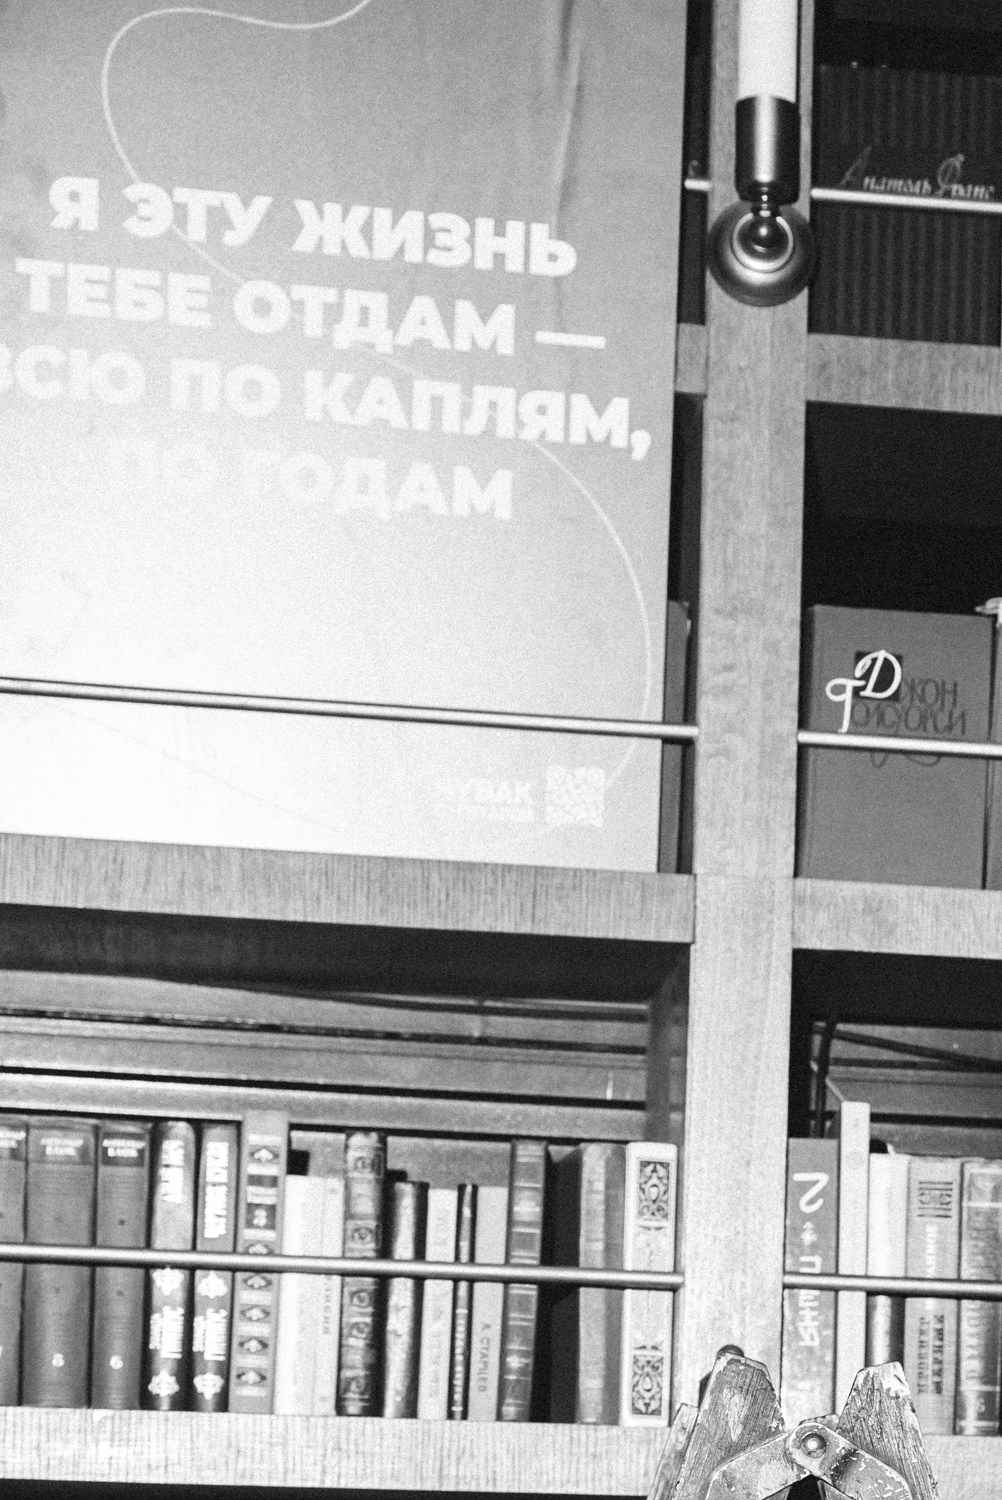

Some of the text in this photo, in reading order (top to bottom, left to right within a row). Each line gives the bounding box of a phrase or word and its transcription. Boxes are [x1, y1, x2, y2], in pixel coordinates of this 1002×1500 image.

[48, 177, 577, 278] Я ЭТУ ЖИЗНЬ
[15, 258, 212, 328] ТЕБЕ
[234, 280, 516, 355] ОТДАМ
[170, 356, 282, 418] ПО
[304, 368, 651, 460] КАПЛЯМ,
[242, 450, 513, 521] ГОДАМ
[798, 1254, 823, 1347] ПШНЯ
